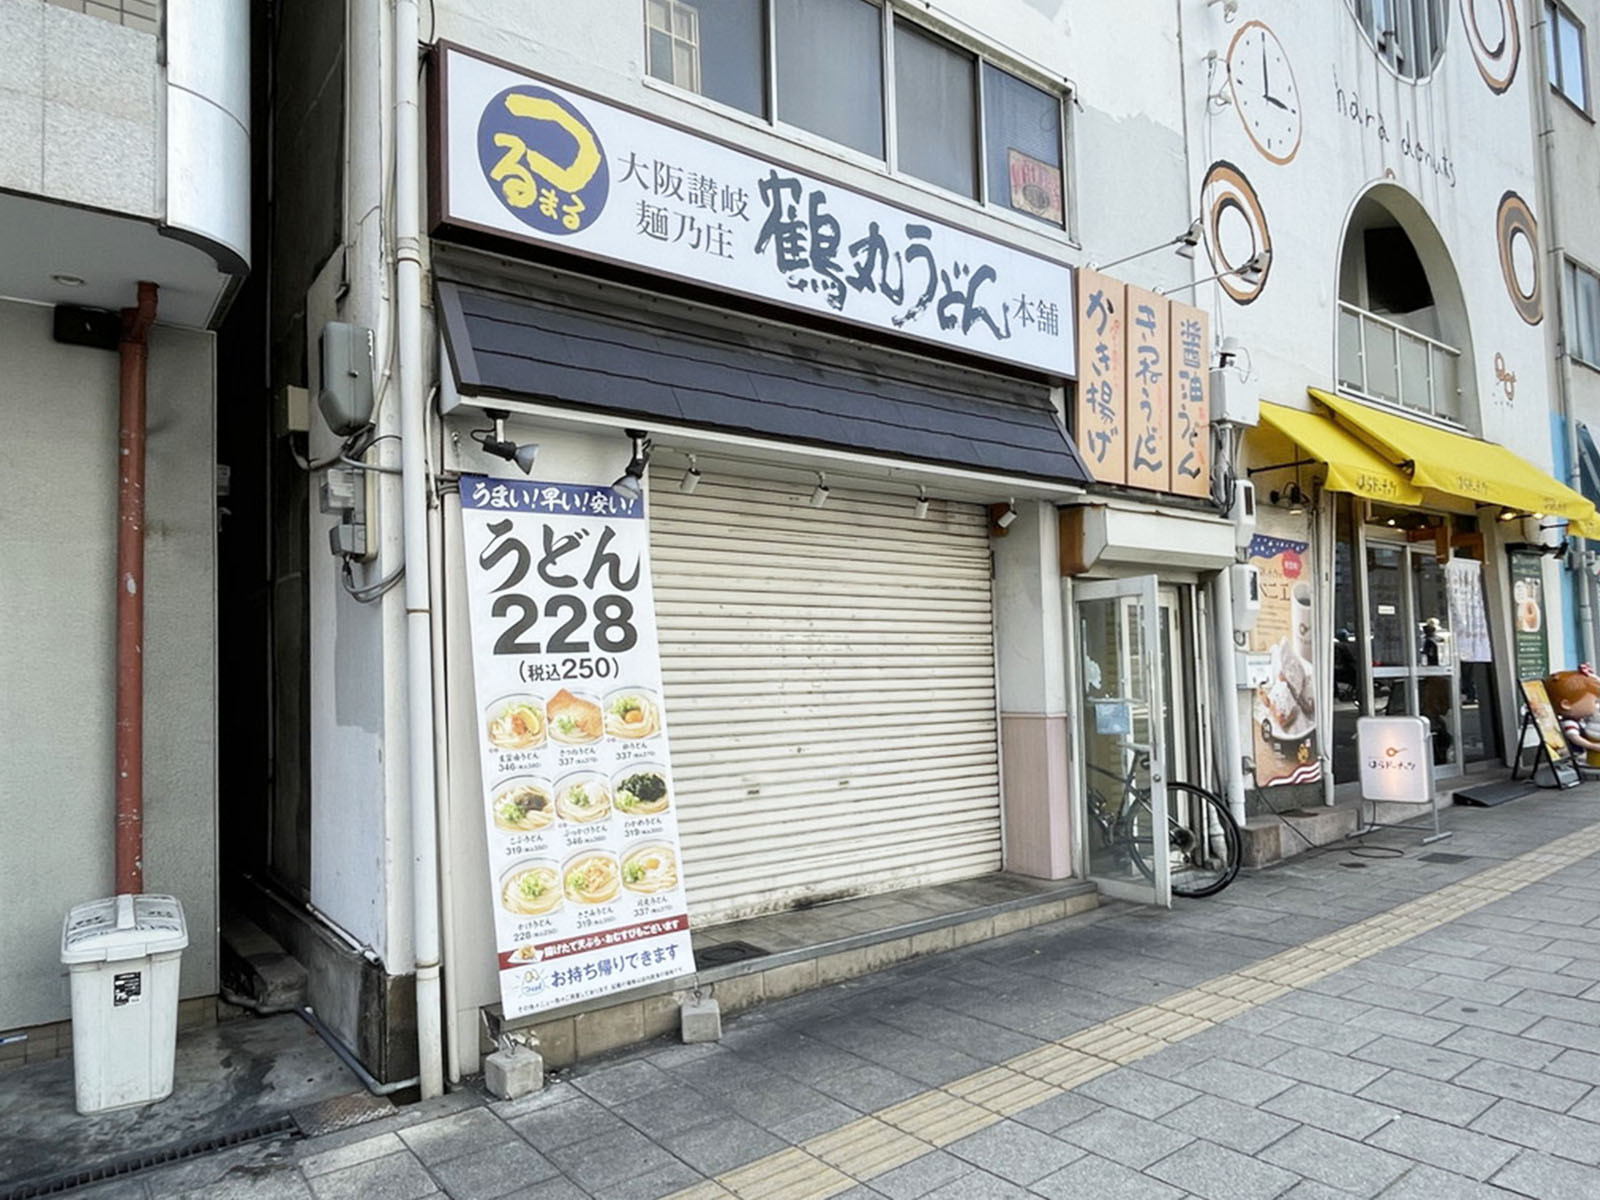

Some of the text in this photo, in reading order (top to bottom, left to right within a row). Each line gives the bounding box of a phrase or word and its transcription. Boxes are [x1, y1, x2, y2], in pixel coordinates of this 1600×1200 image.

[1332, 63, 1389, 142] hara
[617, 151, 751, 222] 大阪讃岐
[636, 200, 735, 260] 麺乃庄
[754, 168, 1011, 341] 鶴丸うどん
[1012, 294, 1060, 338] 本舗
[1086, 289, 1119, 464] かき揚げ
[479, 518, 641, 594] うどん
[491, 593, 638, 655] 228
[551, 943, 679, 988] お持ち帰りできます
